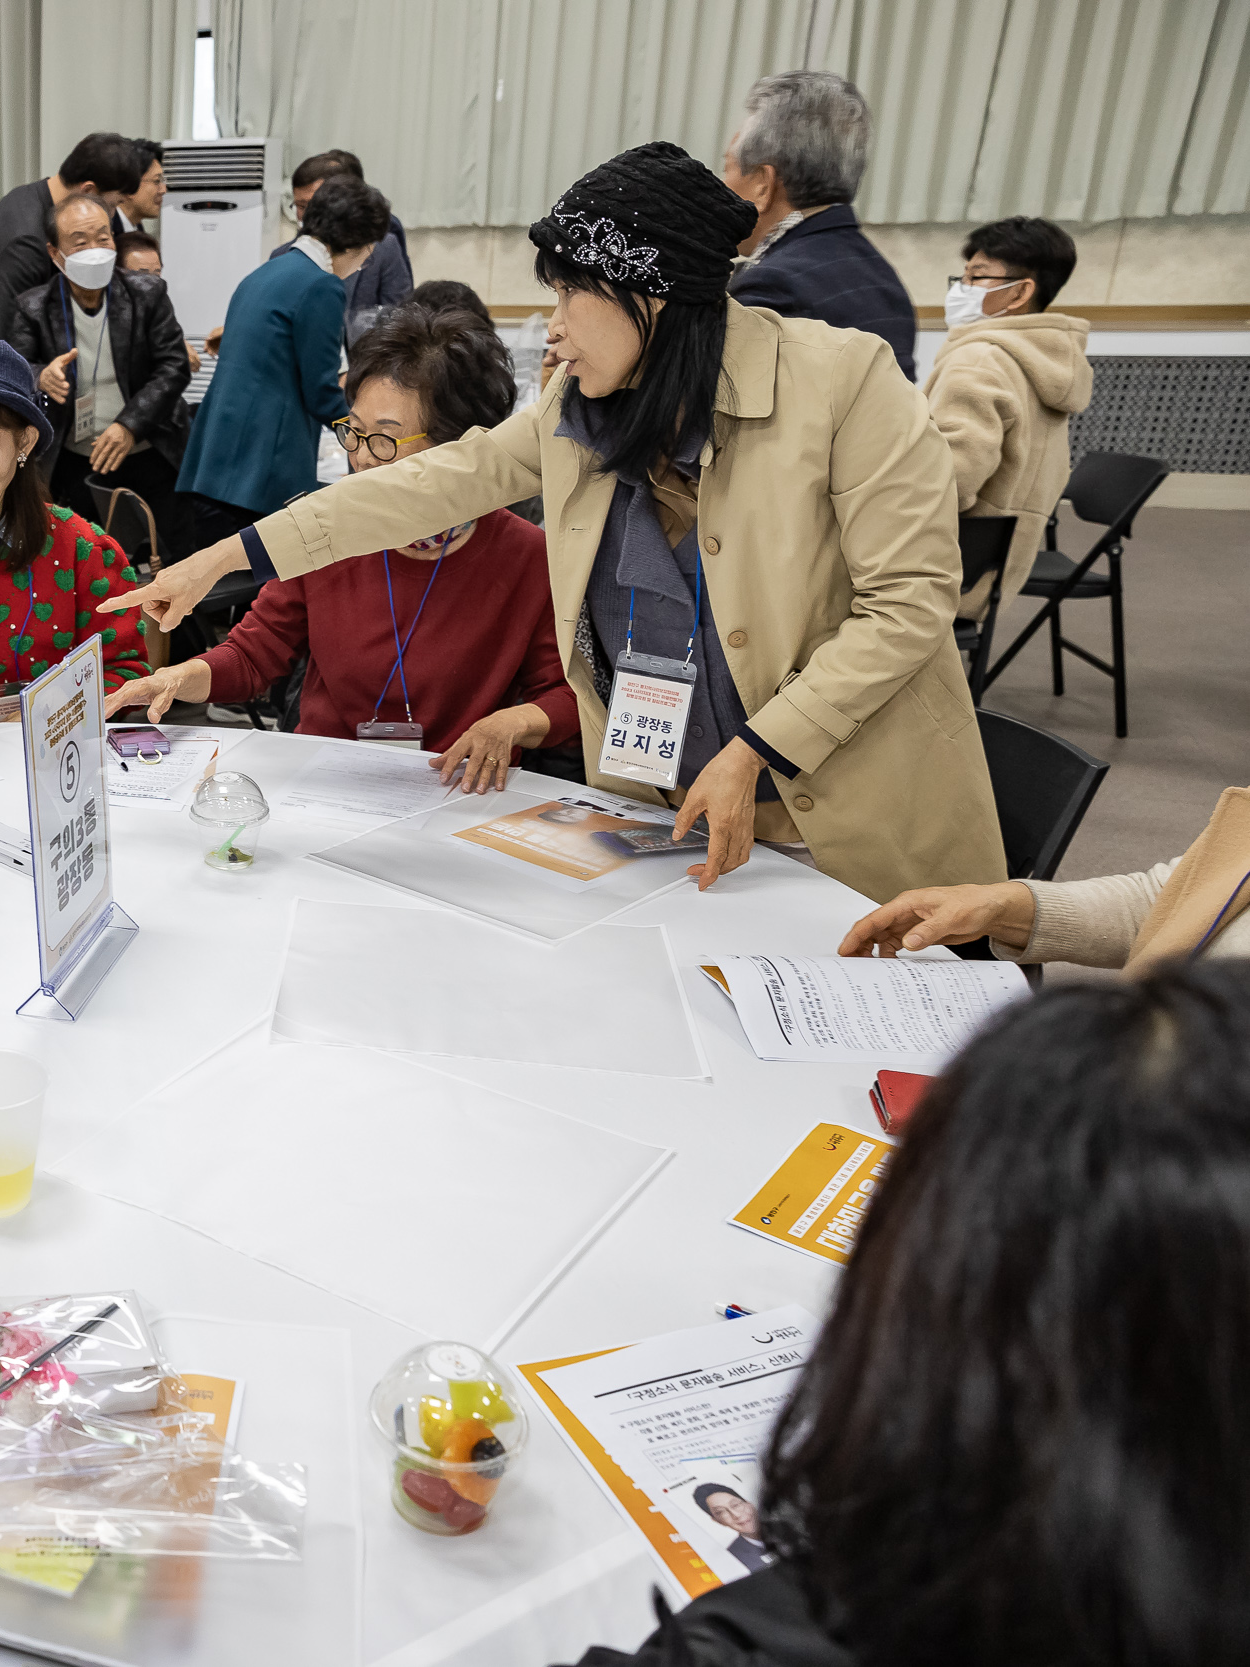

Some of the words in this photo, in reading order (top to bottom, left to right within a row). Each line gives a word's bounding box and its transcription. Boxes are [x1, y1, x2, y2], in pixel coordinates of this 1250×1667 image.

[636, 715, 673, 734] 광장동
[49, 798, 97, 872] 구의3동
[56, 841, 94, 912] 광장동
[679, 1372, 725, 1390] 문자발송
[768, 1349, 803, 1368] 신청서
